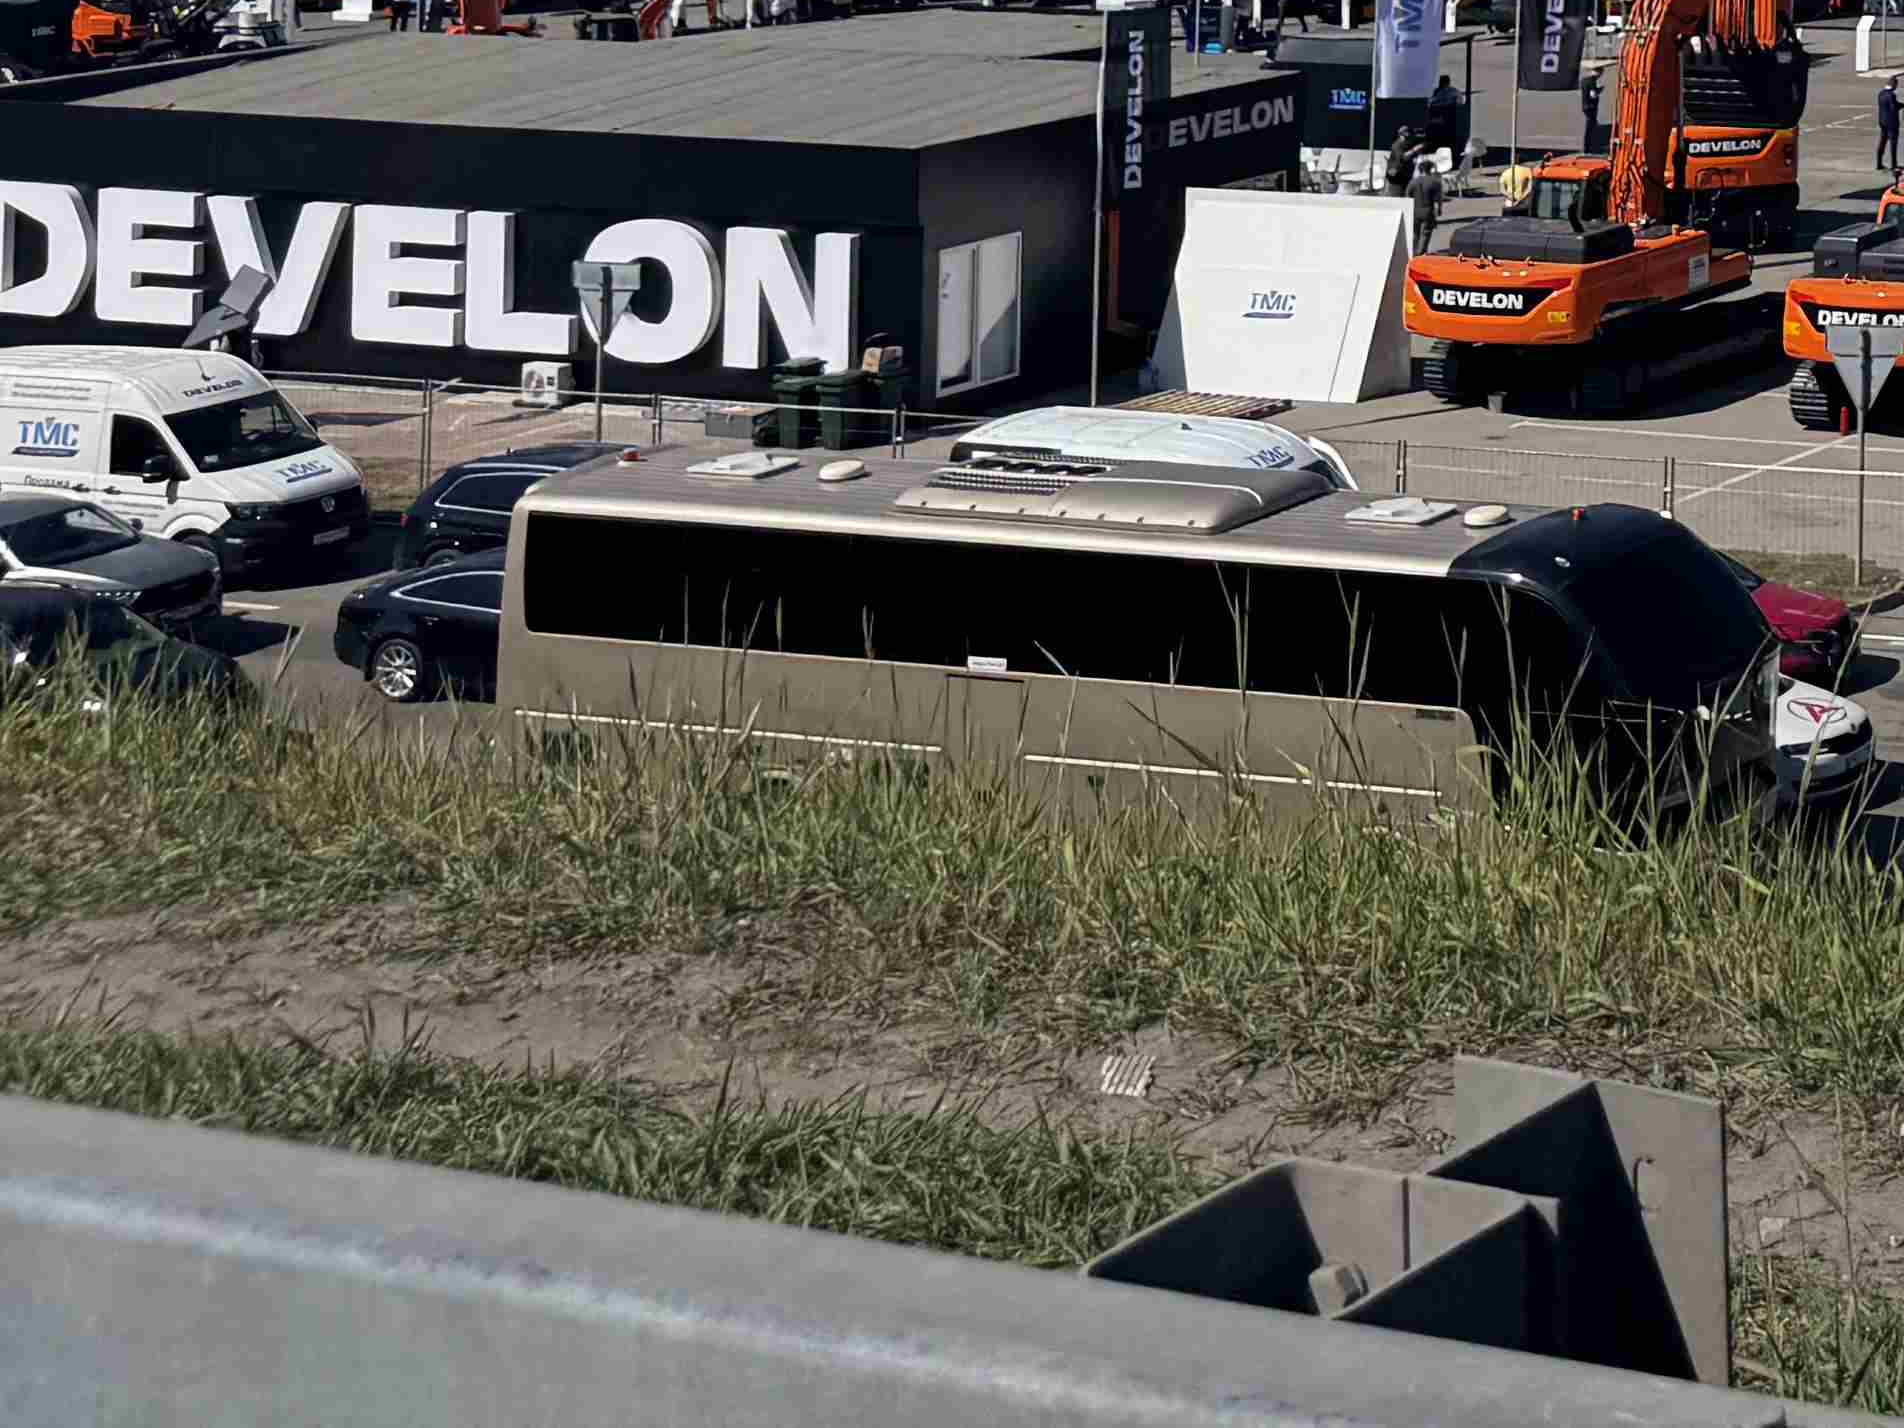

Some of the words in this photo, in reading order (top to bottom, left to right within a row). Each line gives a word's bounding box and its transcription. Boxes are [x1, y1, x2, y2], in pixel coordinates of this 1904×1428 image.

[1124, 29, 1146, 190] DEVELON
[1688, 138, 1762, 155] DEVELON
[0, 180, 862, 378] DEVELON
[1433, 288, 1524, 310] DEVELON
[184, 379, 243, 397] DEVELON
